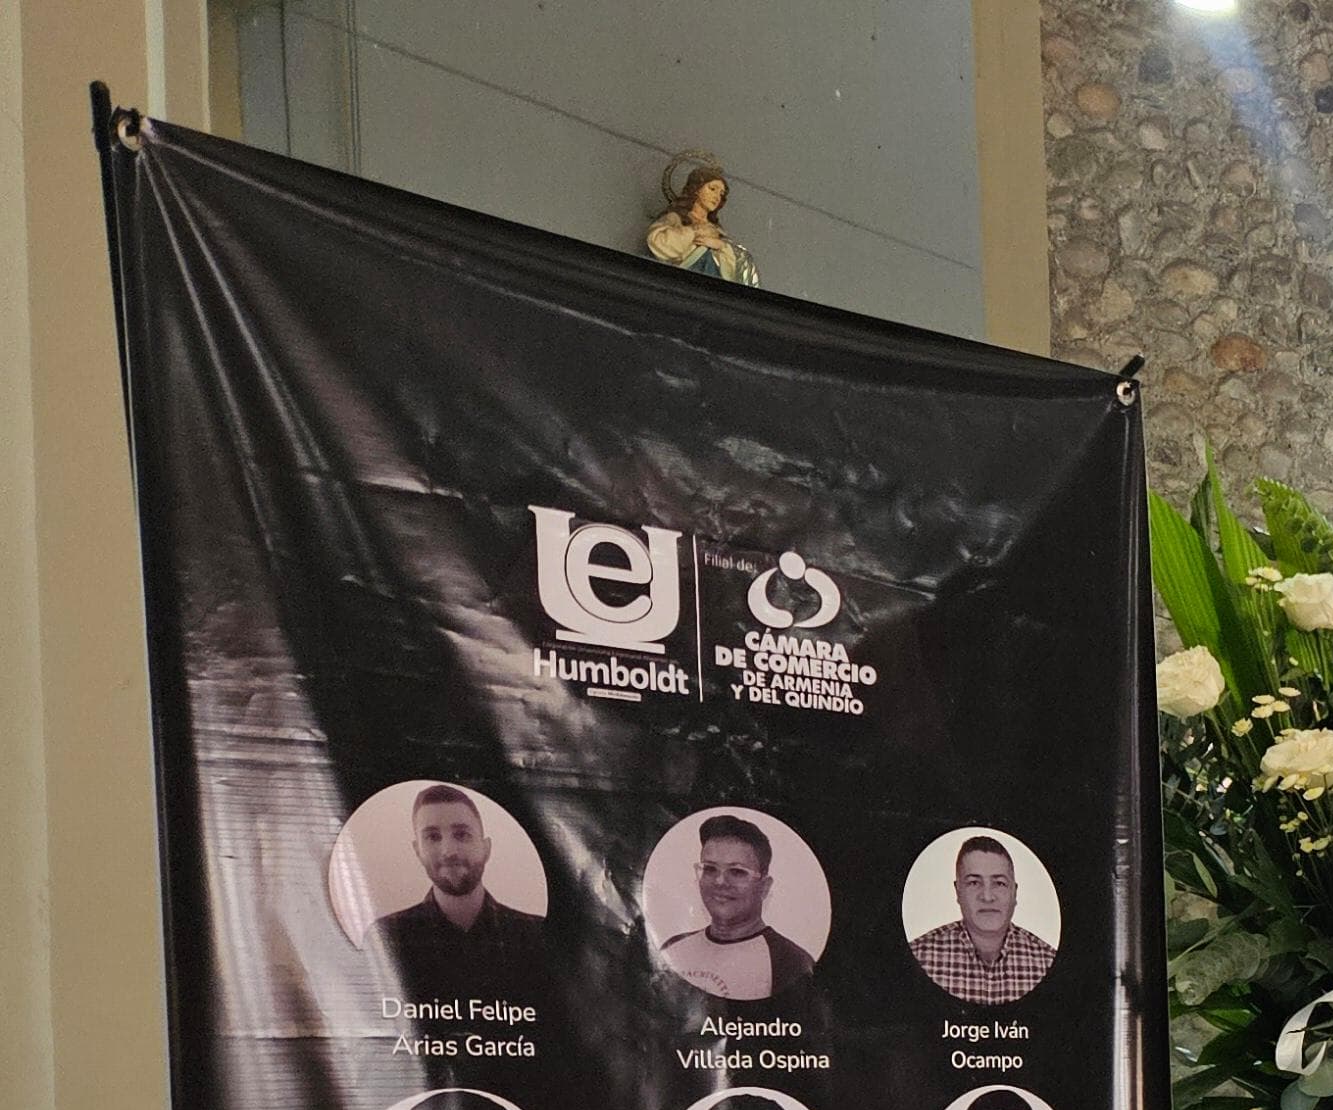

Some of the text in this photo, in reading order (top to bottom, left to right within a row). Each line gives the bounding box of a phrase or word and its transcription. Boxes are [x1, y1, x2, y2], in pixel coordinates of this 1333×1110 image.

[744, 628, 849, 663] CÁMARA
[533, 647, 690, 695] Humboldt
[715, 645, 878, 686] DE COMERCIO
[730, 684, 744, 700] Y
[749, 687, 781, 705] DEL
[743, 670, 854, 699] DE ARMENIA
[381, 997, 537, 1026] Daniel Felipe
[700, 1016, 802, 1041] Alejandro
[941, 1019, 1030, 1043] Jorge Iván
[391, 1034, 536, 1058] Arias García
[676, 1048, 831, 1073] Villada Ospina
[950, 1051, 1024, 1074] Ocampo
